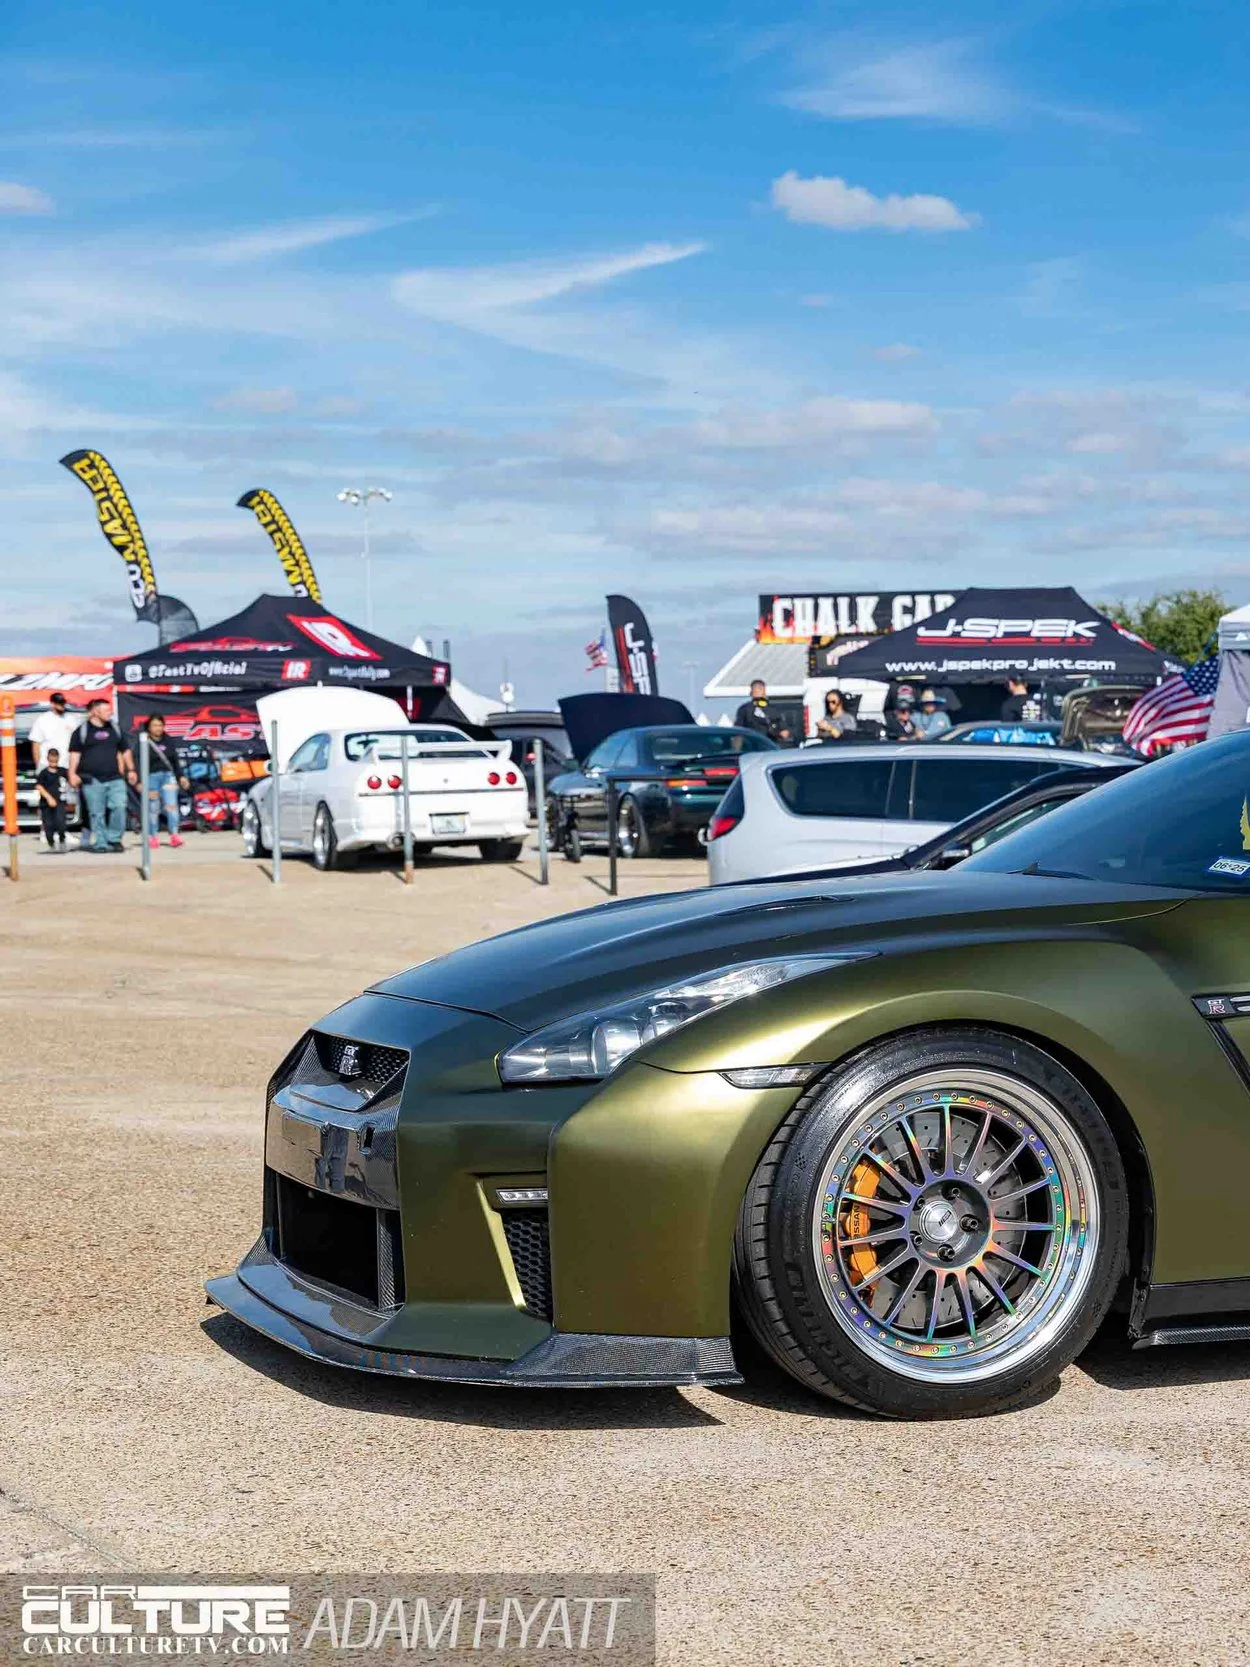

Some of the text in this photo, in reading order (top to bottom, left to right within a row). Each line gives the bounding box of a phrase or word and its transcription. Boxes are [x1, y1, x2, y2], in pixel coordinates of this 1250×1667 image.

[772, 594, 880, 638] CHALK
[916, 617, 1101, 639] J-SPEK
[885, 658, 1116, 673] www.jspekprojekt.com
